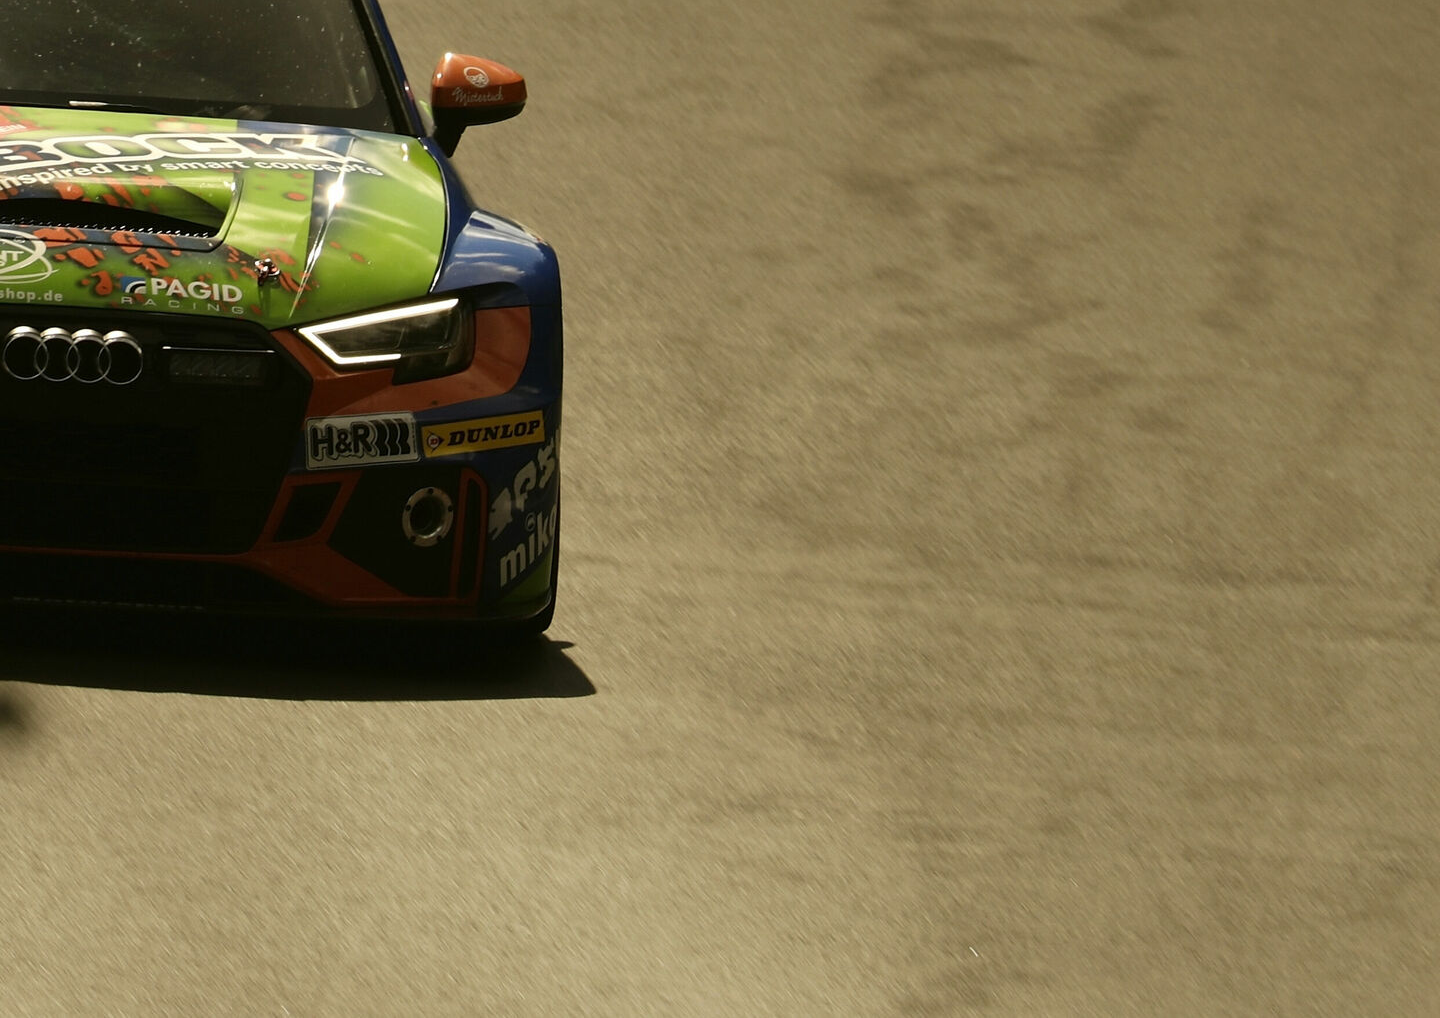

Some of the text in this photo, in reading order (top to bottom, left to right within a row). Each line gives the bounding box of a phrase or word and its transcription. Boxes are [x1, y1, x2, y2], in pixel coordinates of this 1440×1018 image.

[114, 163, 154, 173] by
[161, 160, 250, 171] smart
[254, 159, 384, 177] concepts
[151, 277, 243, 302] PAGID
[120, 296, 244, 315] RACING
[446, 419, 540, 447] DUNLOP
